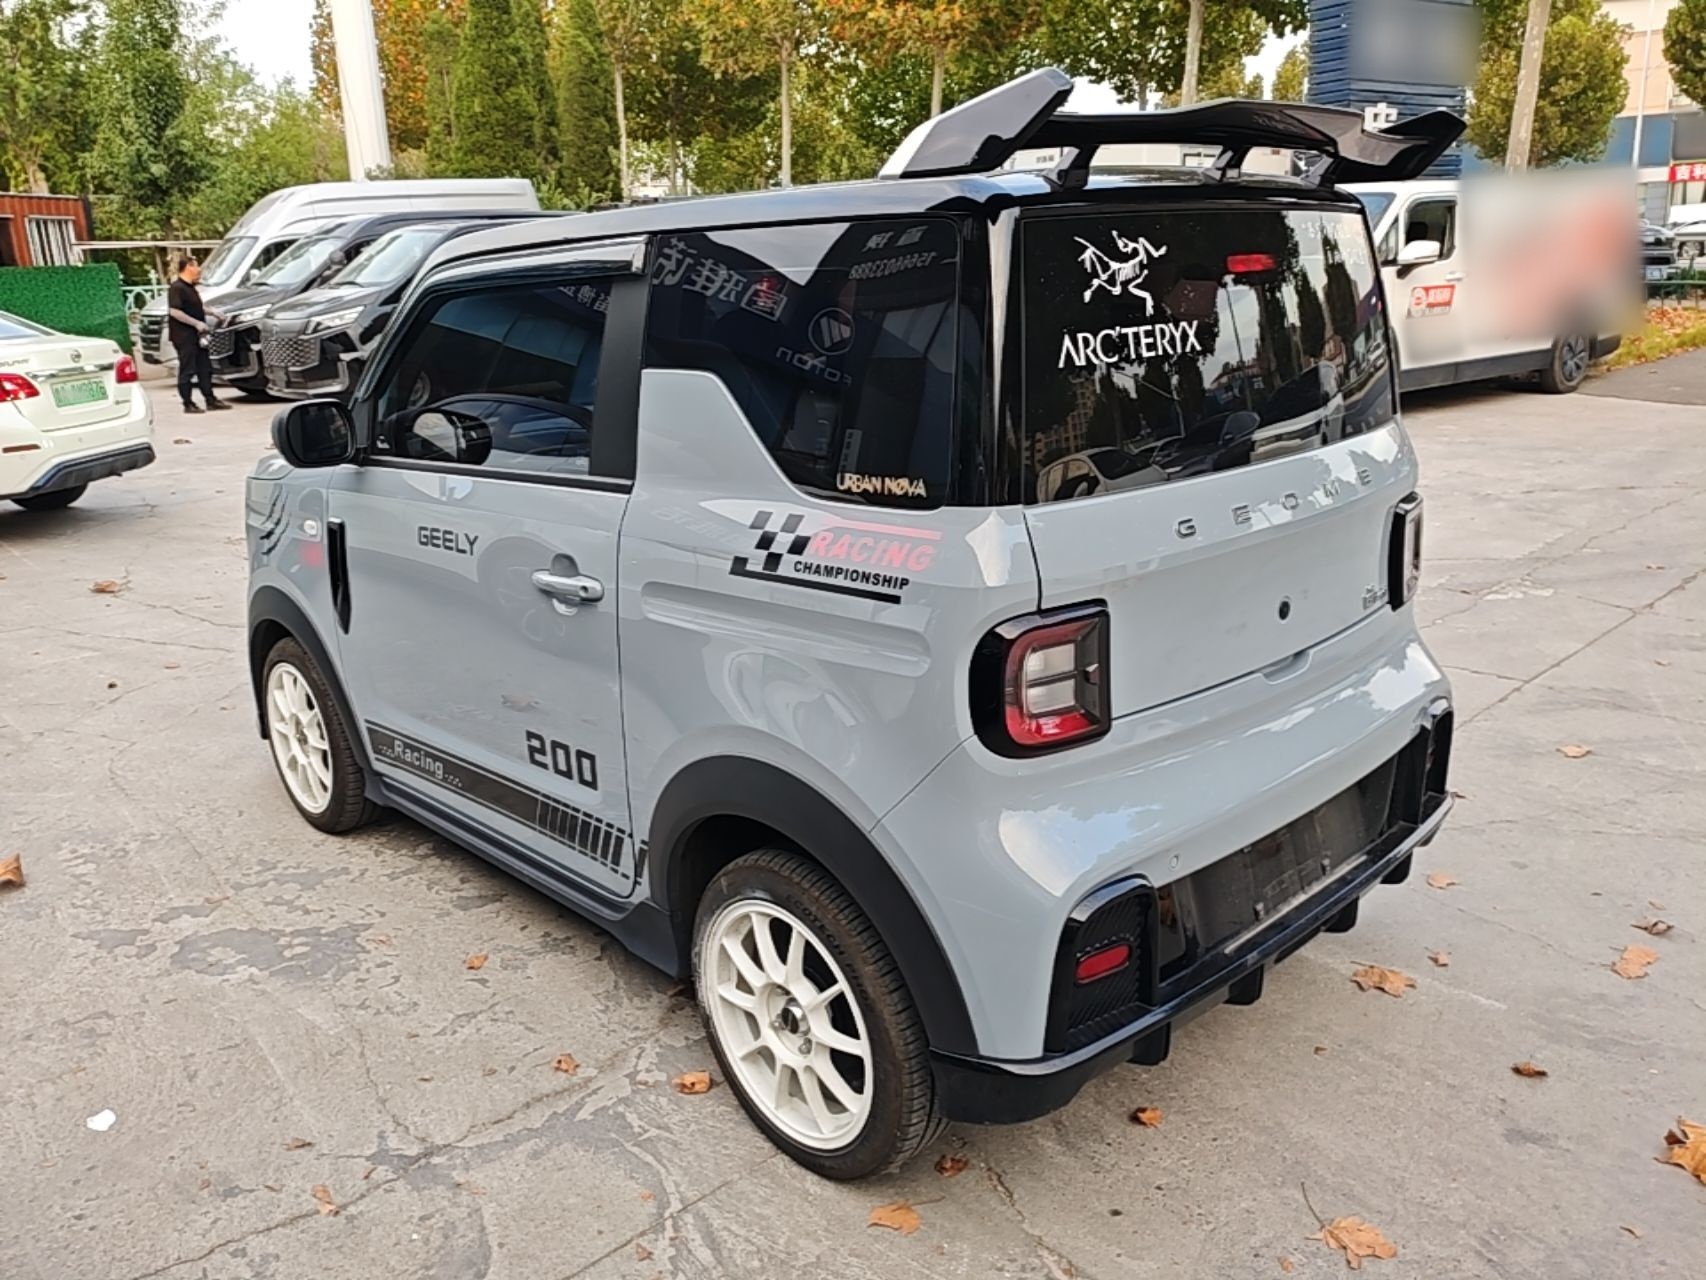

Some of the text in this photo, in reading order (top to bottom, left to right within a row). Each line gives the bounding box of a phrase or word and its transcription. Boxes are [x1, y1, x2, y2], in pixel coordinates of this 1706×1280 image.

[1058, 320, 1202, 369] ARC'TERYX
[836, 472, 882, 494] URBAN
[1175, 469, 1373, 539] GEOME
[418, 526, 479, 556] GEELY
[809, 531, 935, 571] RACING
[794, 560, 911, 590] CHAMPIONSHIP
[394, 740, 444, 779] Racing
[525, 730, 598, 791] 200
